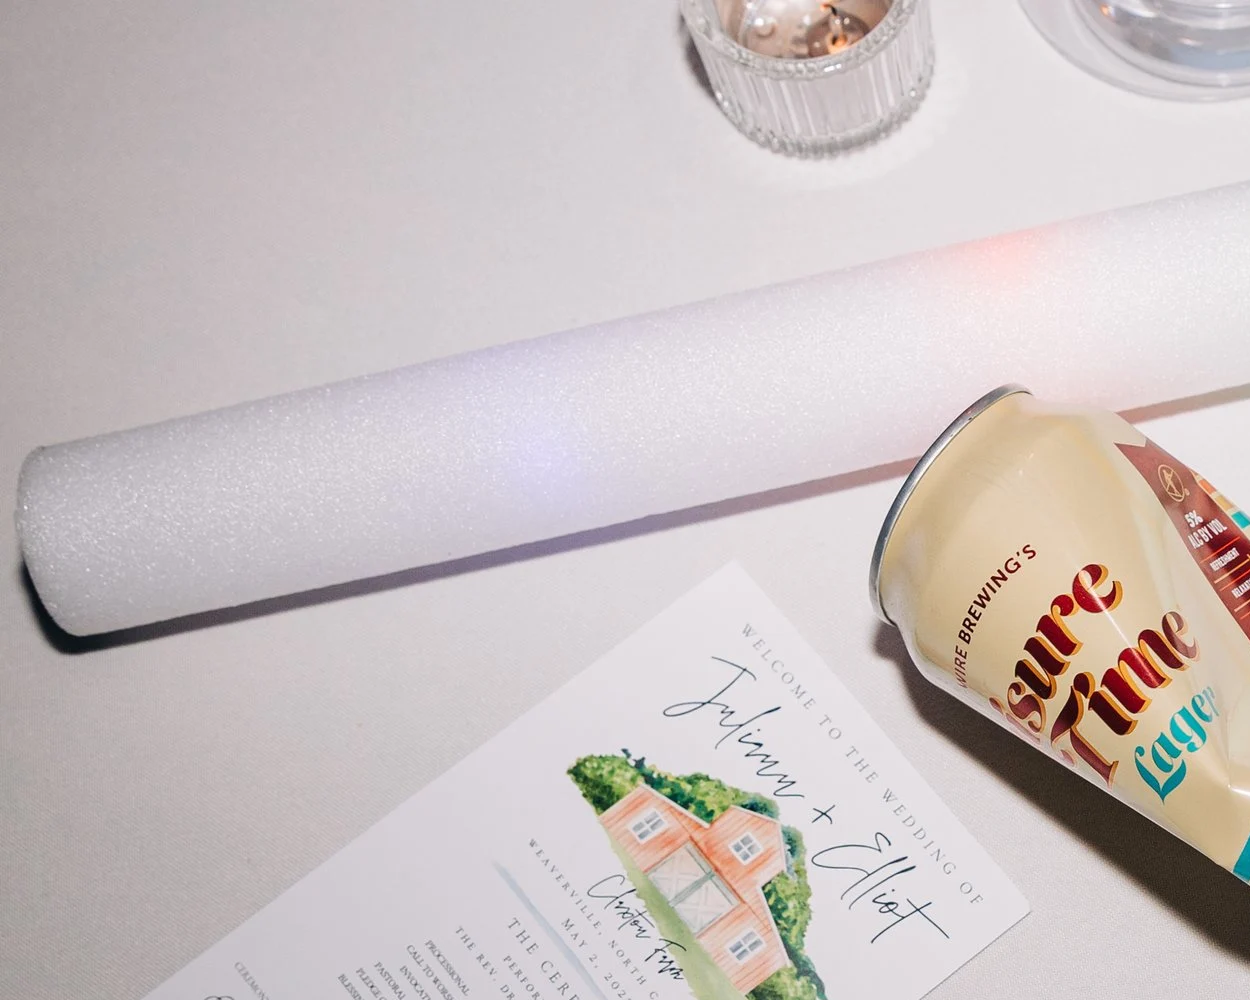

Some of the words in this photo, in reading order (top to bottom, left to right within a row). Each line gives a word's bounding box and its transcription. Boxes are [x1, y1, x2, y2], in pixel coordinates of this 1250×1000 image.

[1184, 510, 1203, 528] 5%
[1188, 532, 1202, 550] ALC
[1200, 525, 1213, 543] BY
[1209, 518, 1227, 537] VOL
[958, 543, 1037, 646] BREWING'S
[1050, 611, 1200, 789] Time
[742, 623, 816, 710] WELCOME
[818, 714, 842, 740] TO
[845, 745, 879, 783] THE
[882, 787, 957, 875] WEDDING
[959, 881, 984, 904] OF
[1134, 685, 1219, 804] Lager
[529, 838, 602, 936] WEAVERVILLE,
[608, 939, 647, 985] NORTH
[811, 832, 948, 943] Elliot
[424, 940, 470, 996] PROCESSIONAL
[455, 926, 476, 951] THE
[476, 953, 497, 981] REV.
[508, 917, 539, 955] THE
[561, 918, 588, 948] MAY
[588, 953, 598, 969] 2,
